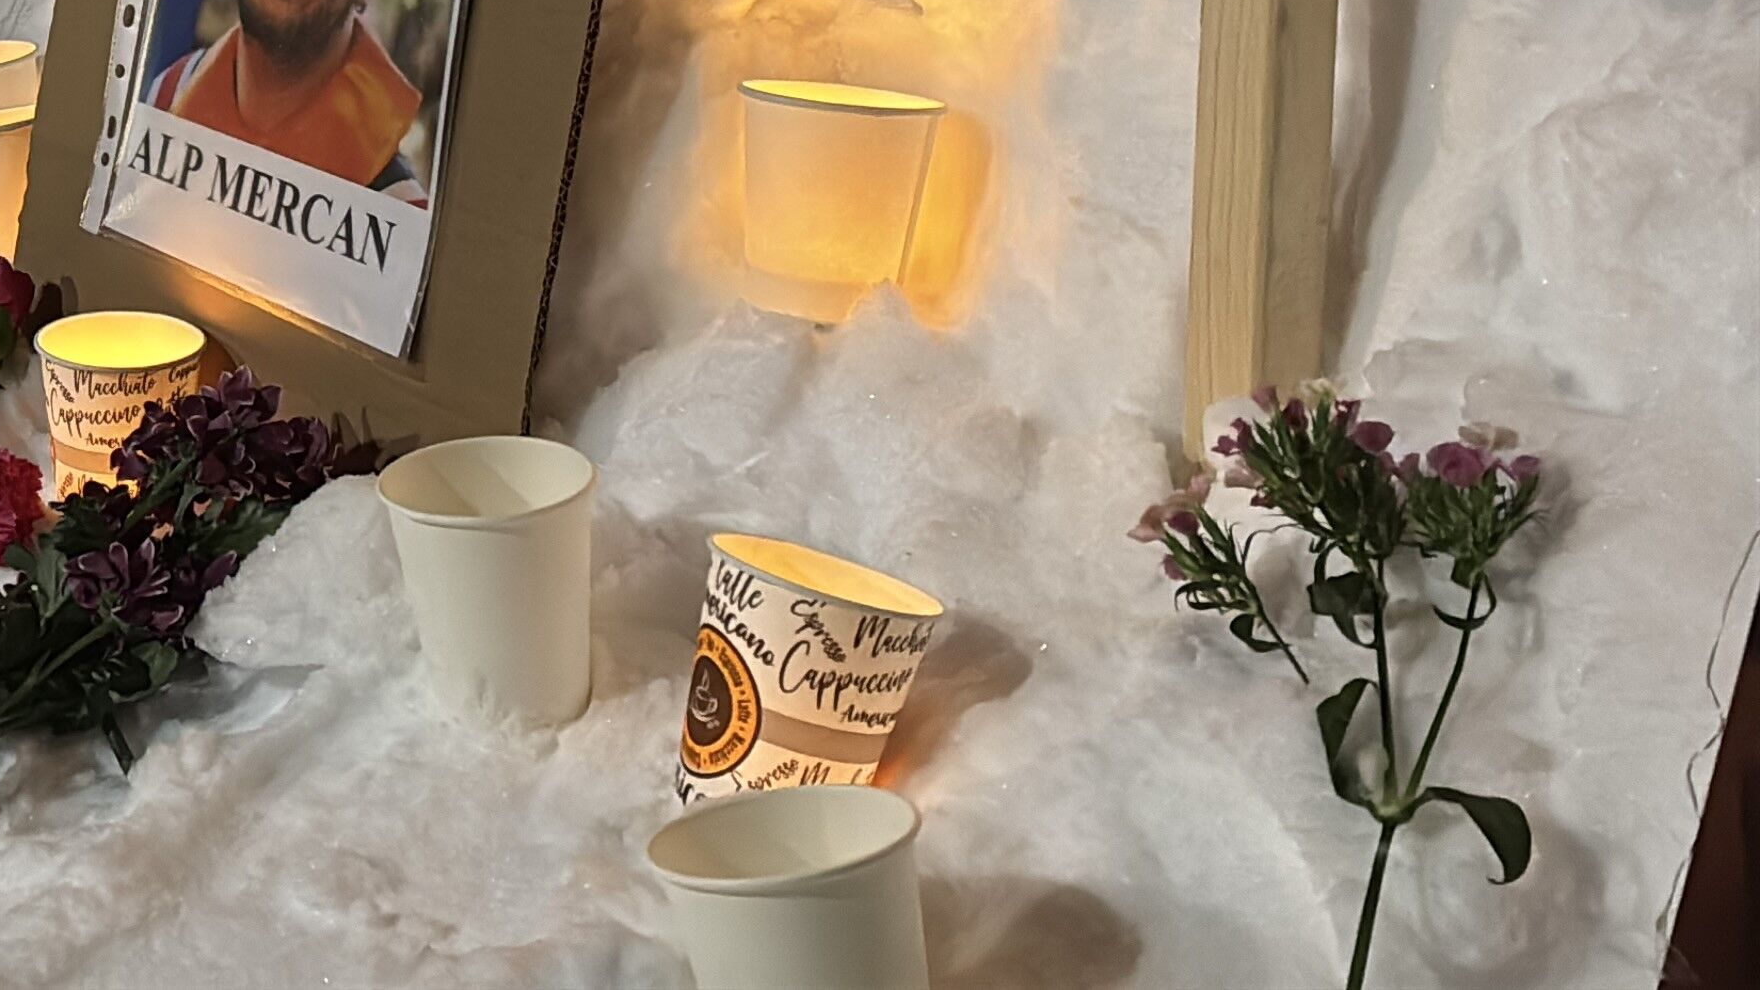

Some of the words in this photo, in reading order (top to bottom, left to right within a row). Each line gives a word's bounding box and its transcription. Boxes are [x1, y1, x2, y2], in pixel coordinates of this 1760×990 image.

[128, 128, 203, 191] ALP
[207, 155, 397, 274] MERCAN
[73, 368, 157, 400] Macchiato
[50, 388, 141, 439] Cappuccino
